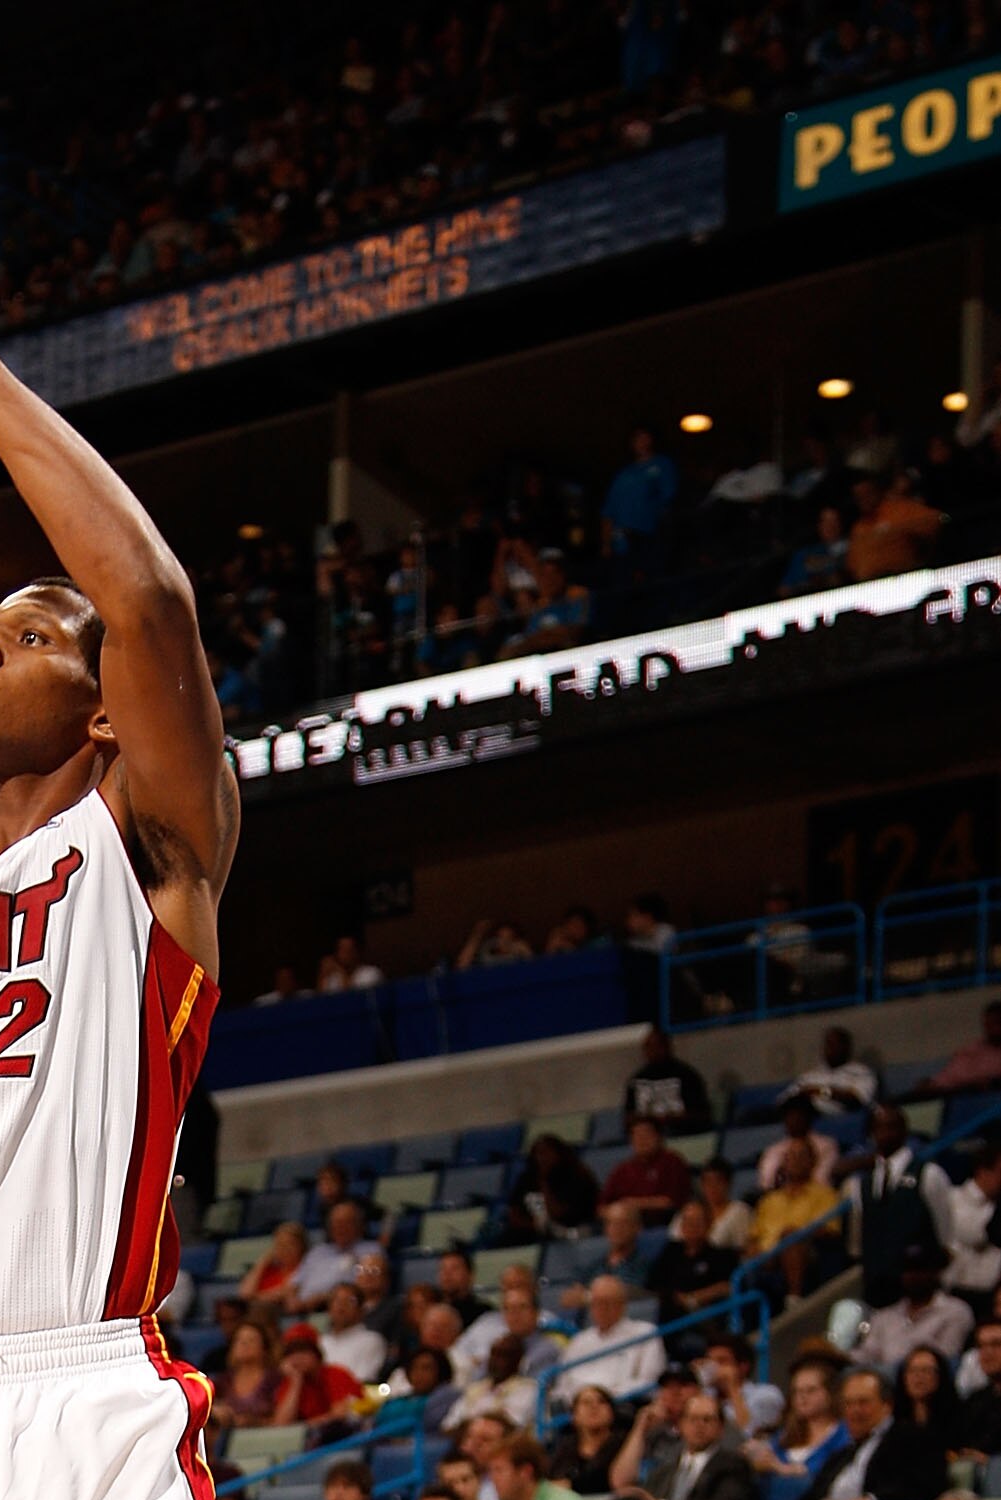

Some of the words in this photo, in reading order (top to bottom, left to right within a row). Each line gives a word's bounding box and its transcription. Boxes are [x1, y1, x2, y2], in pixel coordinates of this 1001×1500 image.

[794, 71, 1001, 191] PEOP
[127, 263, 297, 341] WELCOME
[304, 248, 354, 291] TO
[355, 221, 432, 279] THE
[824, 810, 981, 906] 124
